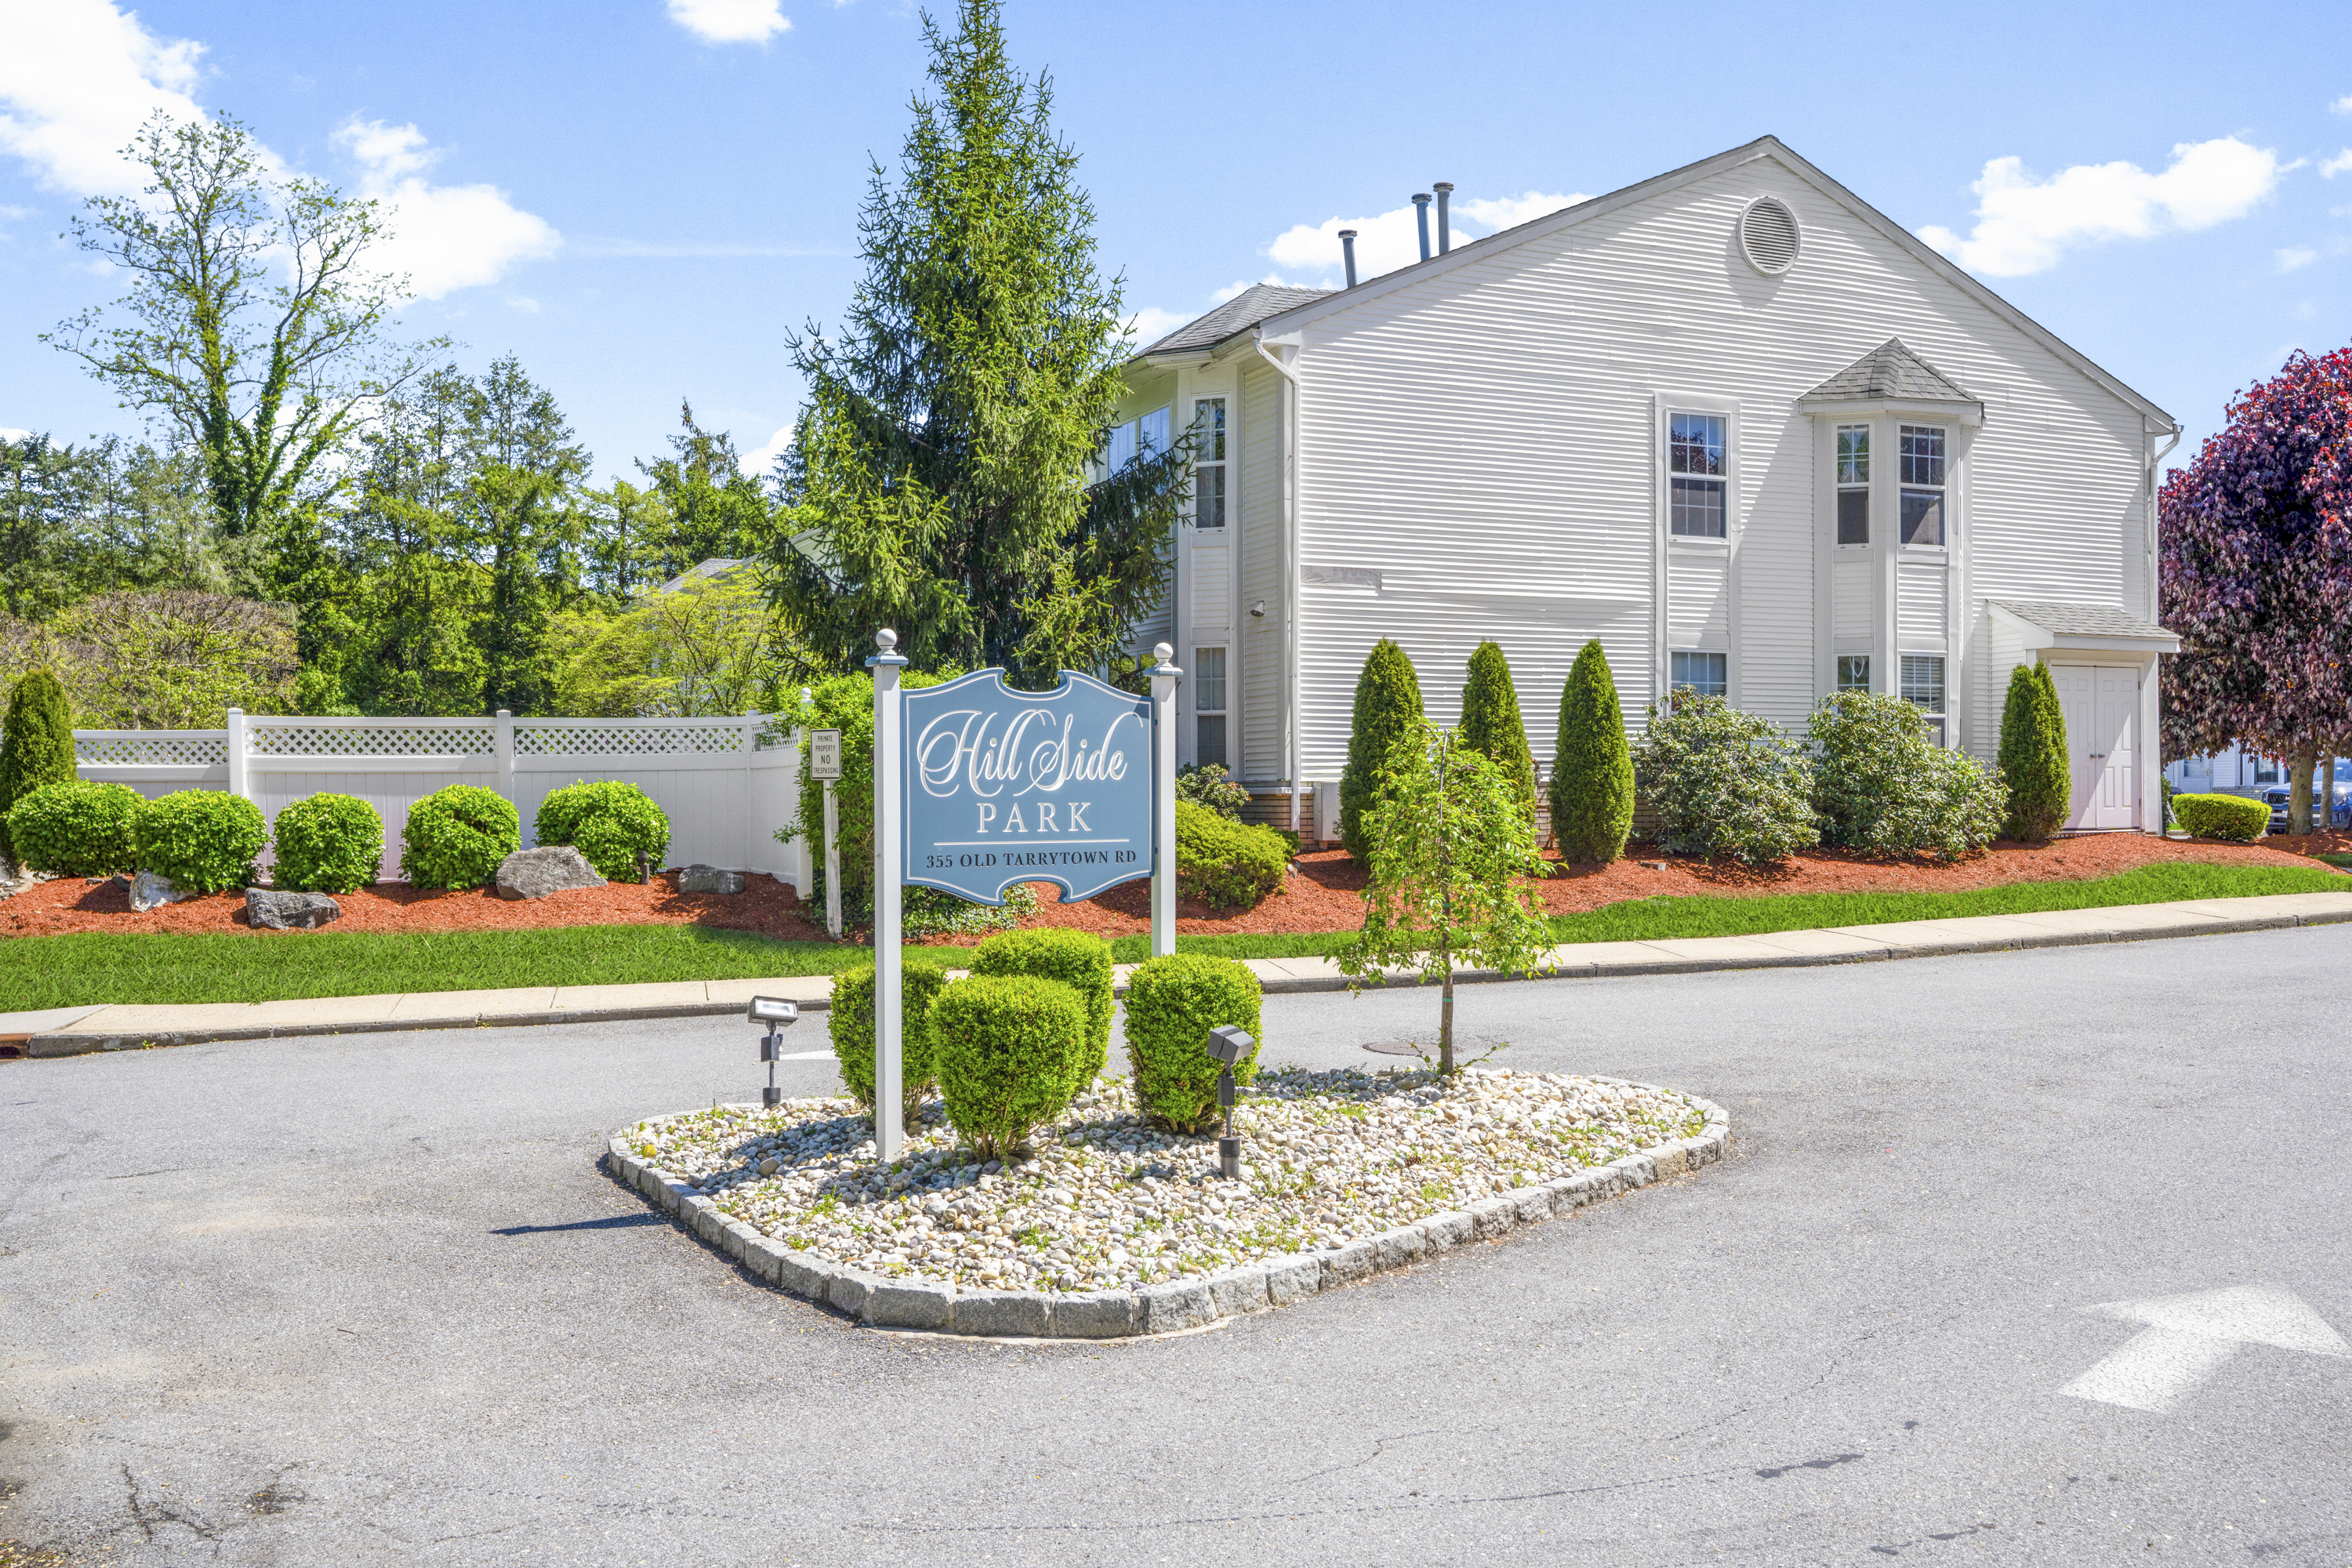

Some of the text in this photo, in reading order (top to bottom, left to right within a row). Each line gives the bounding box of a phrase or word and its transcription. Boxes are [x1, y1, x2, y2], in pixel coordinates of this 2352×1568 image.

[821, 754, 830, 764] NO
[916, 709, 1143, 797] Hill Side
[976, 802, 1092, 833] PARK
[926, 850, 1136, 869] 355 OLD TARRYTOWN RD
